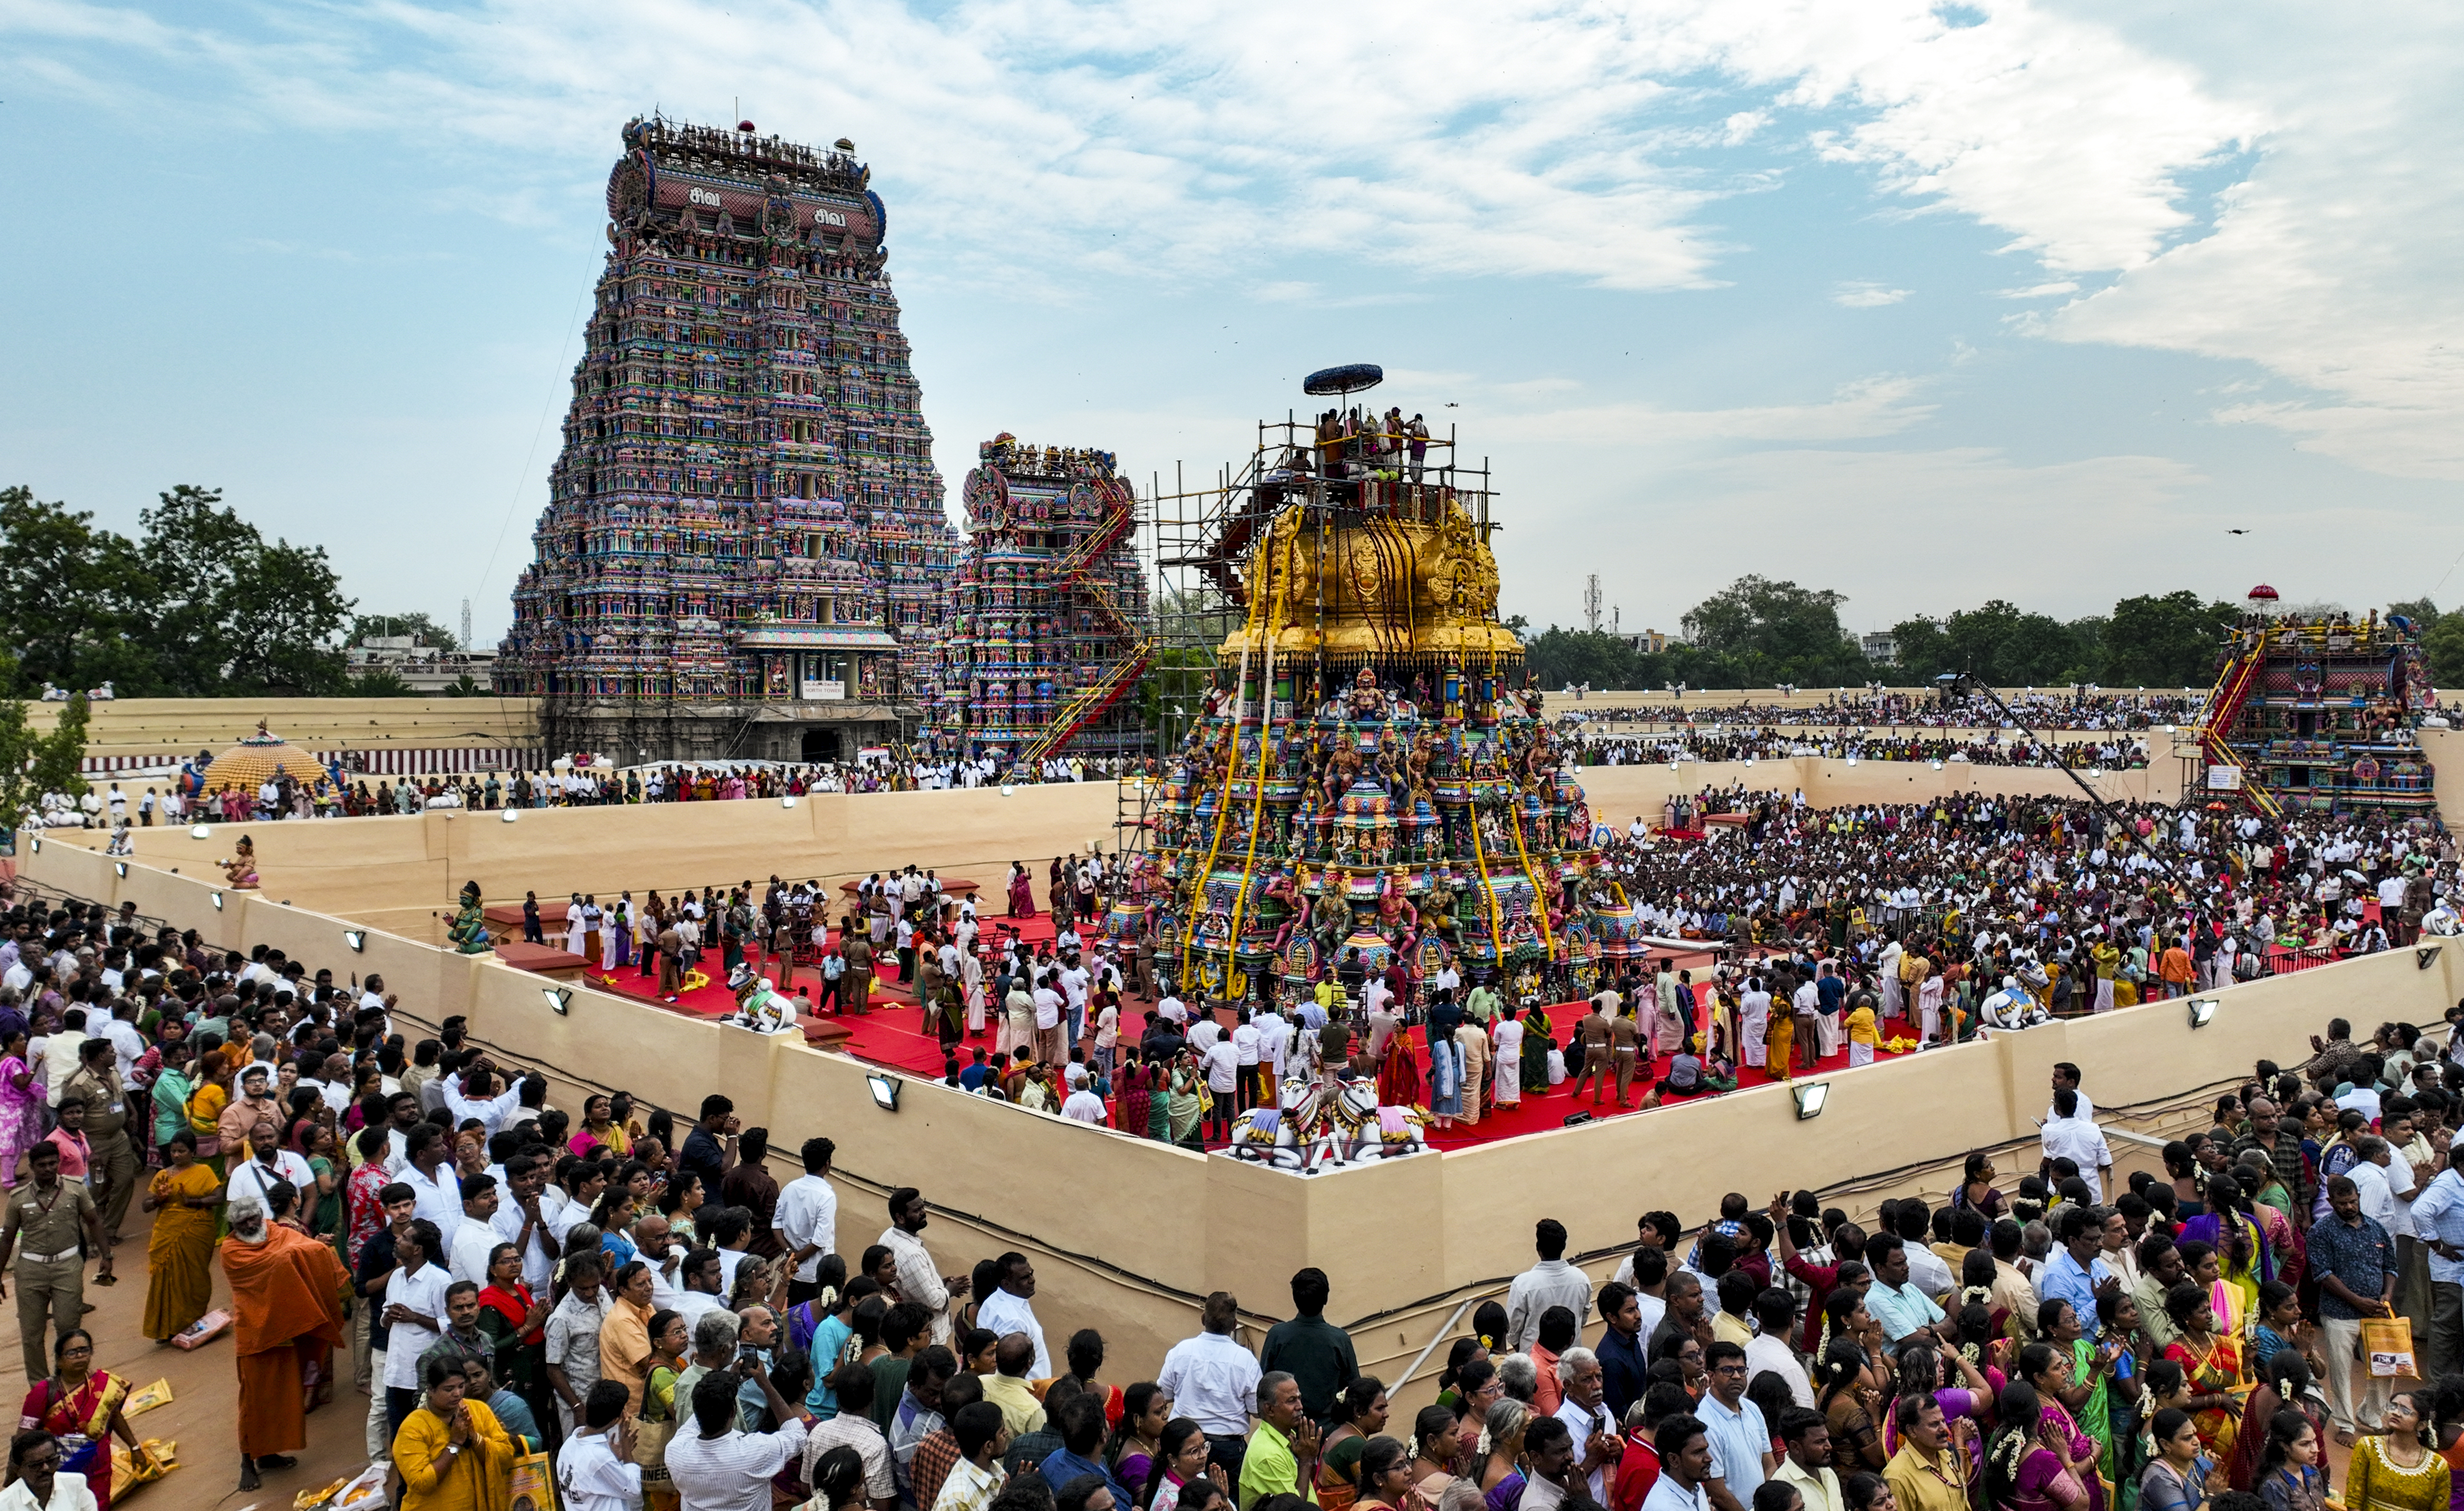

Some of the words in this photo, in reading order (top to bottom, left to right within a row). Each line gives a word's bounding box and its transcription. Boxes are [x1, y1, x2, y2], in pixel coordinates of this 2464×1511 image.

[689, 187, 720, 207] சிவ
[814, 208, 846, 227] சிவ
[641, 1467, 671, 1481] INEE
